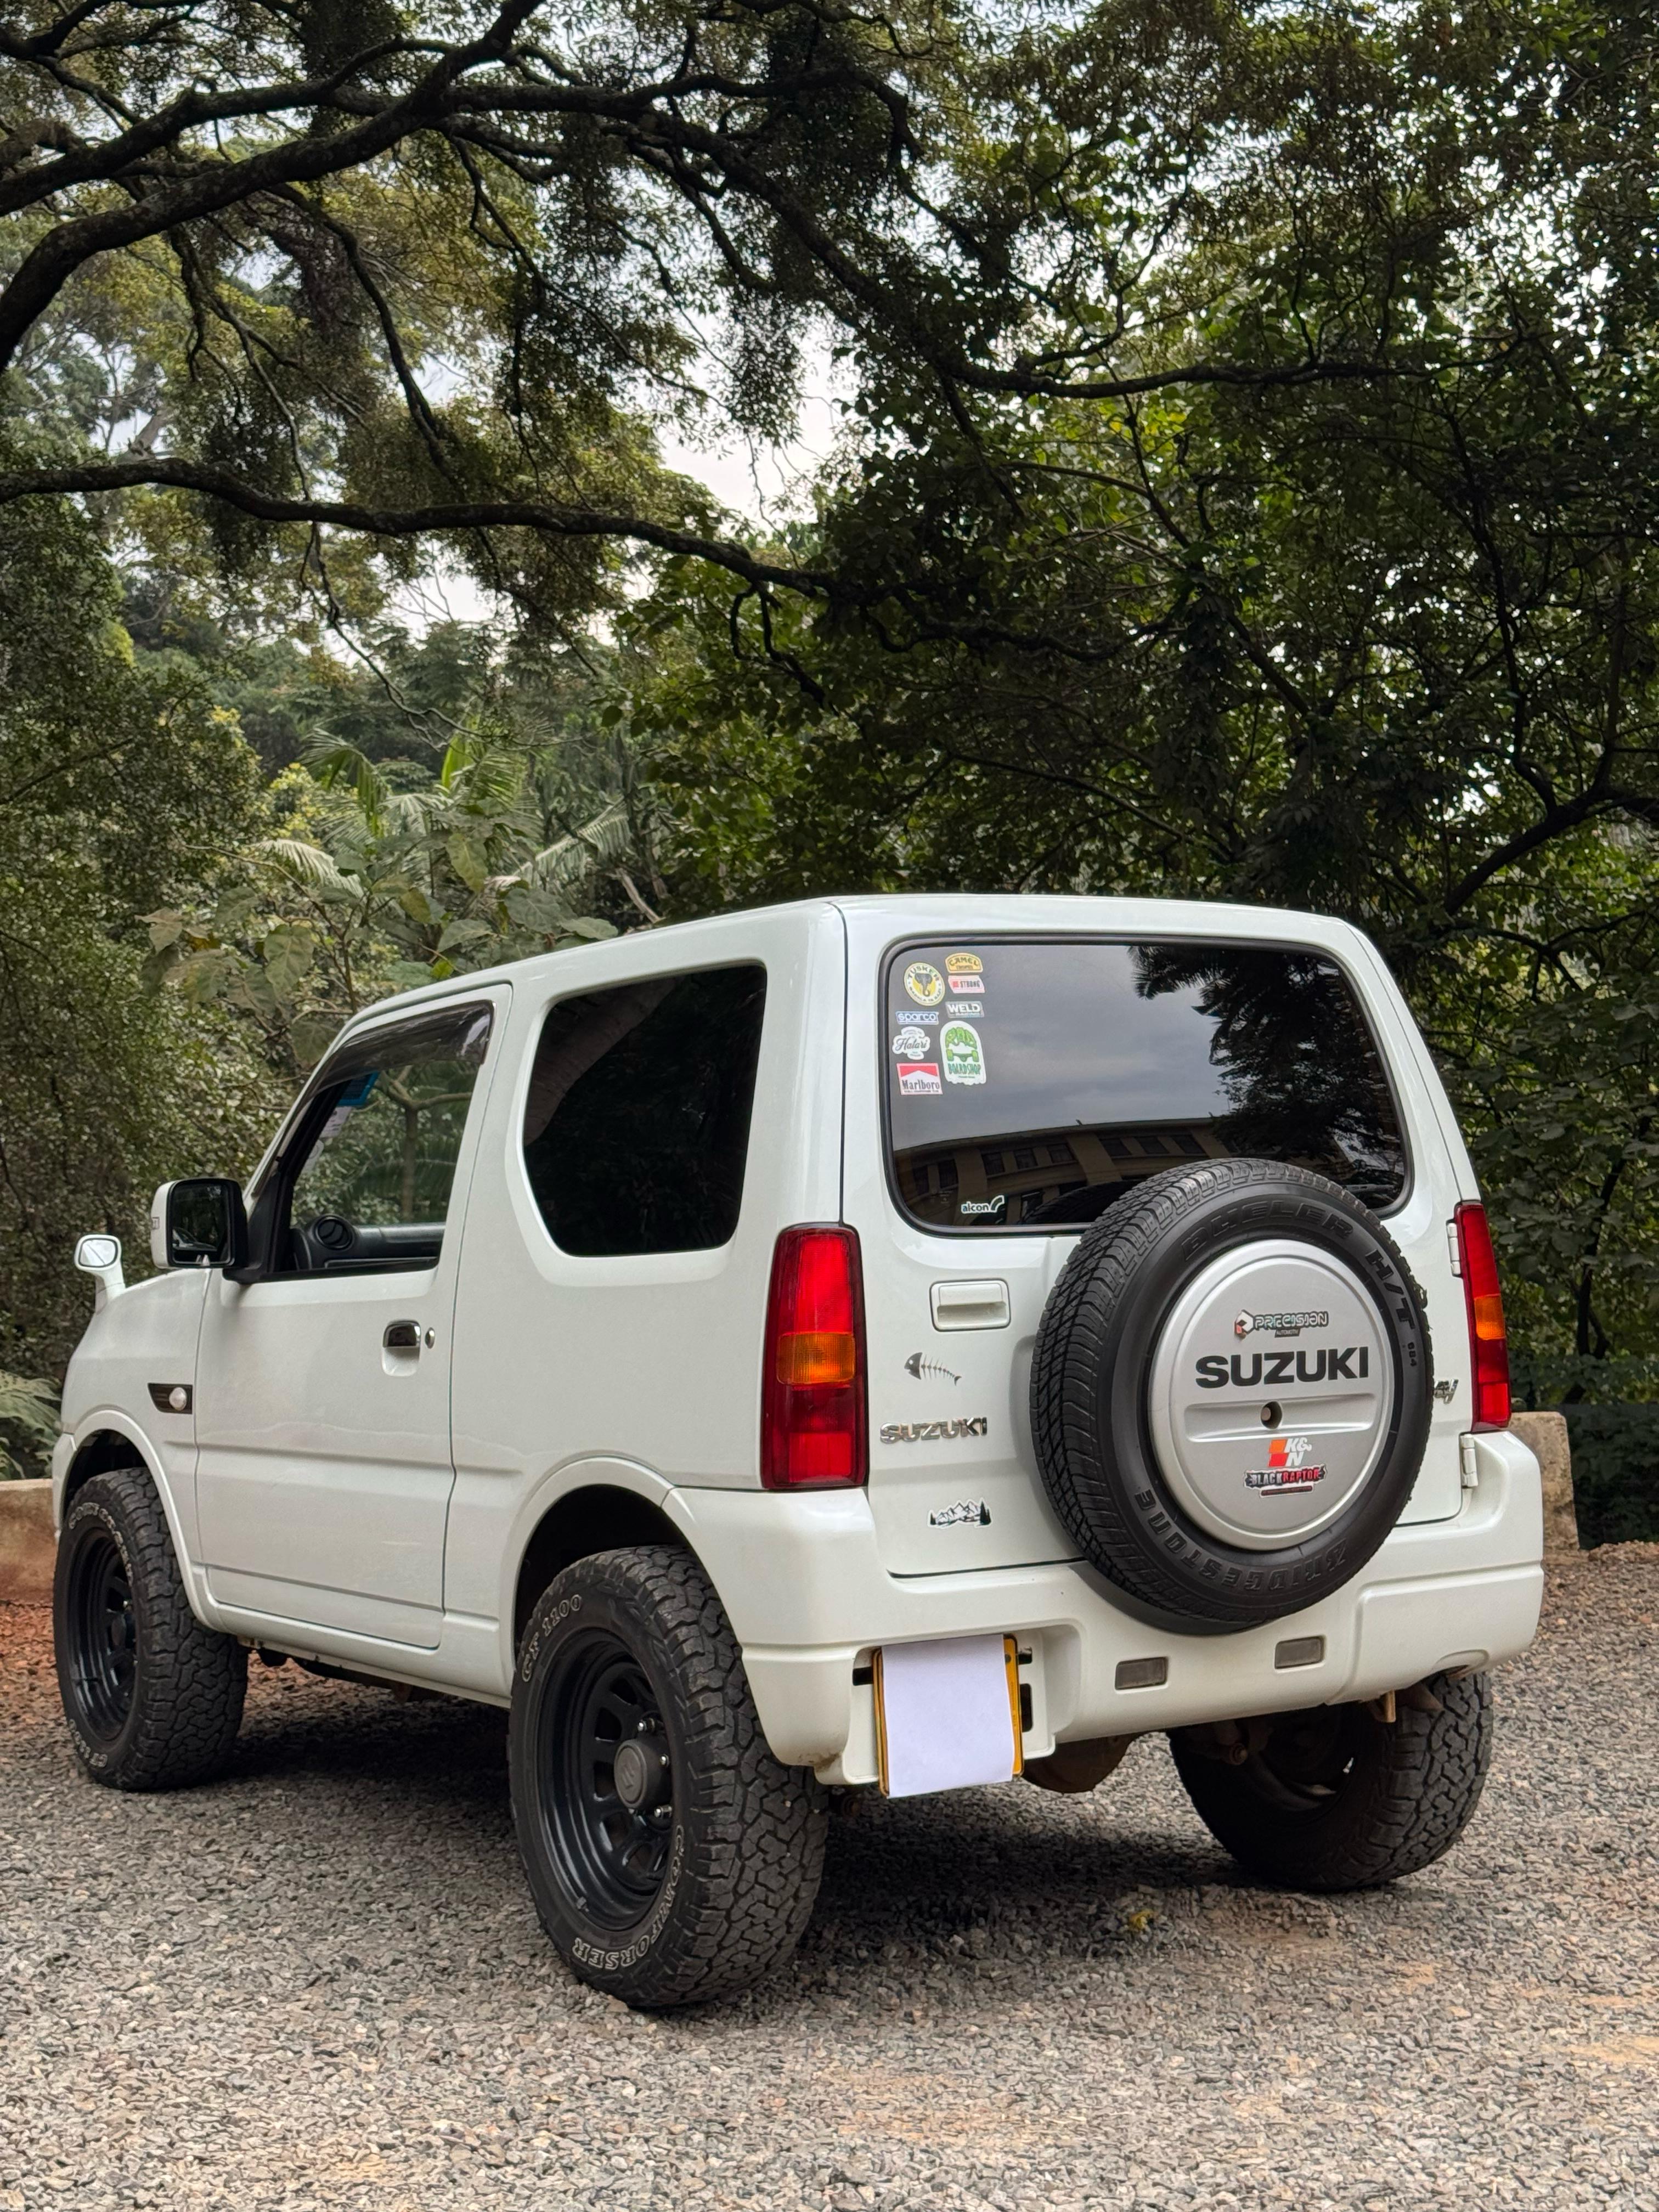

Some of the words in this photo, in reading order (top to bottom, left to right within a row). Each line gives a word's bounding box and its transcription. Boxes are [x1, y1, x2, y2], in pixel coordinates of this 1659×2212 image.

[949, 957, 979, 966] CAMEL
[907, 965, 940, 981] TUSKER
[947, 1003, 980, 1013] WELD
[898, 1012, 936, 1022] sparco
[901, 1079, 940, 1090] Marlboro
[962, 1201, 990, 1213] alcon
[1254, 1312, 1328, 1329] PRECISION
[1195, 1346, 1369, 1390] SUZUKI
[879, 1417, 988, 1444] SUZUKI
[1133, 1488, 1347, 1591] BRIDGESTONE
[541, 1593, 583, 1638] 1100
